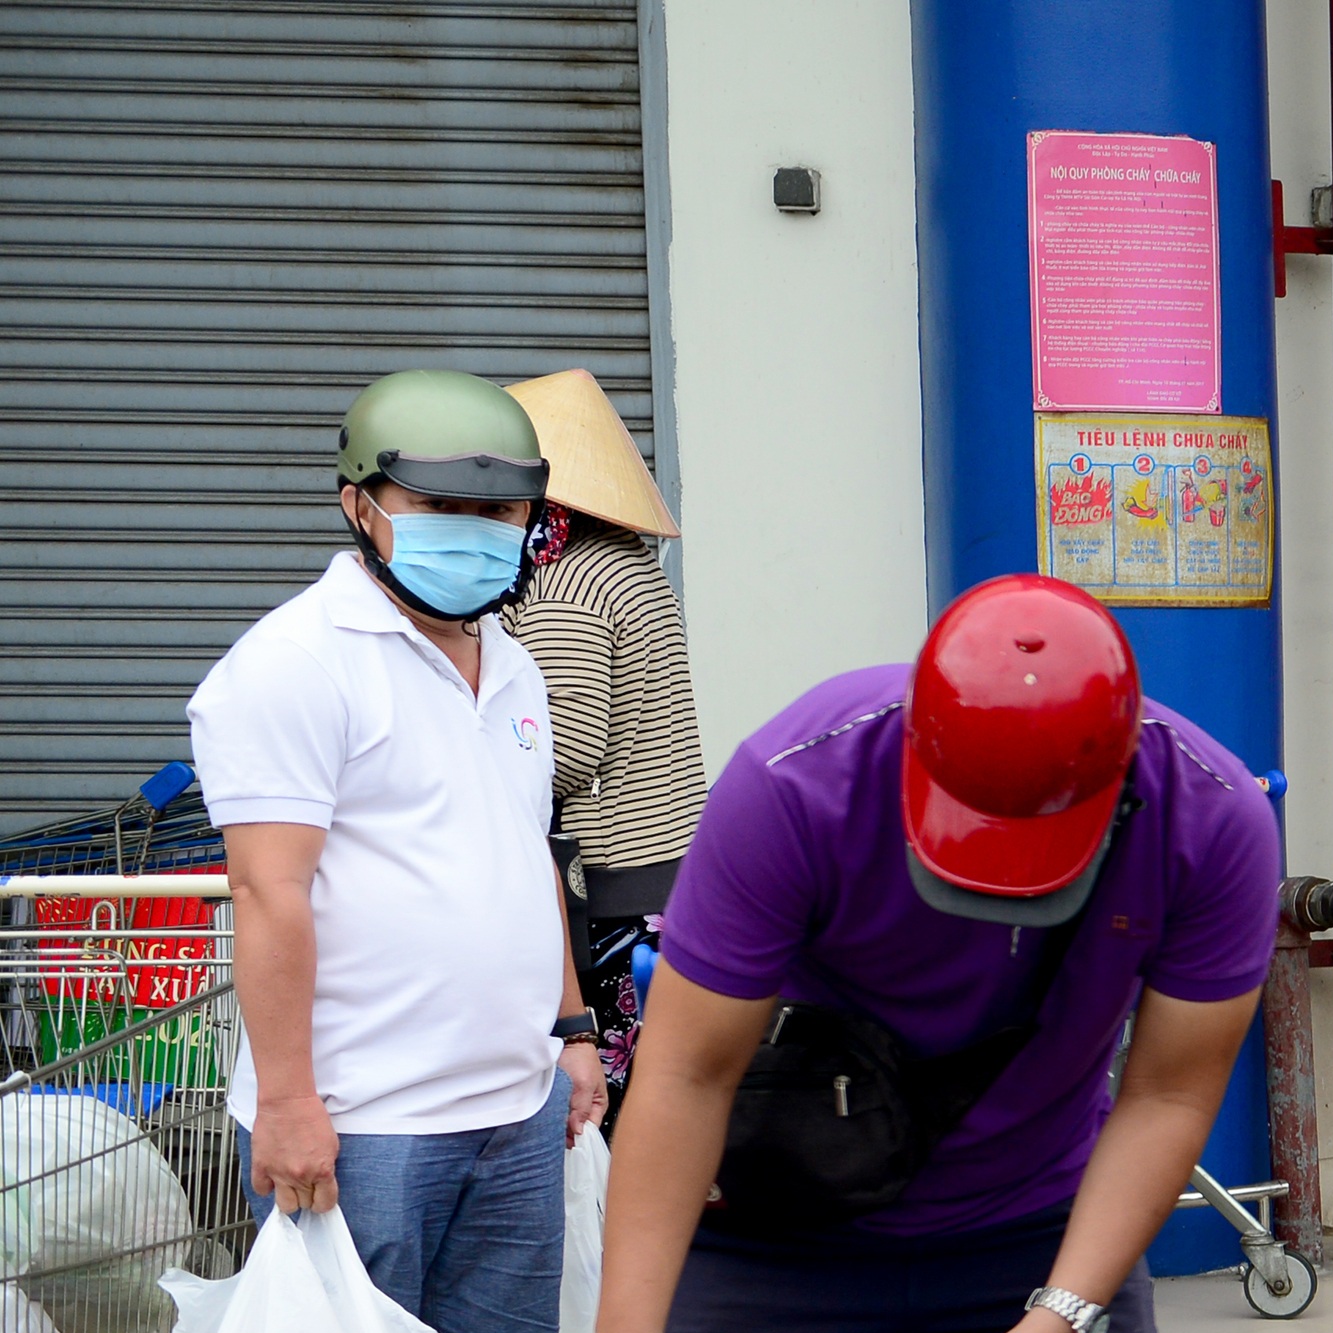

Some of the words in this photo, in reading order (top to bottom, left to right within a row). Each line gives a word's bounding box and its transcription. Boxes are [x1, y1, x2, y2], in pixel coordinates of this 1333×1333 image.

[1050, 165, 1068, 181] NỘI
[1069, 167, 1088, 180] QUY
[1091, 166, 1124, 180] PHÒNG
[1126, 167, 1150, 181] CHÁY
[1154, 168, 1178, 183] CHỮA
[1180, 170, 1201, 184] CHÁY
[1077, 429, 1115, 446] TIÊU
[1123, 429, 1166, 450] LỆNH
[1219, 431, 1248, 450] CHÁY
[1074, 457, 1085, 471] 1
[1137, 457, 1150, 472] 2
[1197, 459, 1208, 473] 3
[1061, 489, 1091, 505] BÁO
[1055, 504, 1102, 523] ĐỘNG
